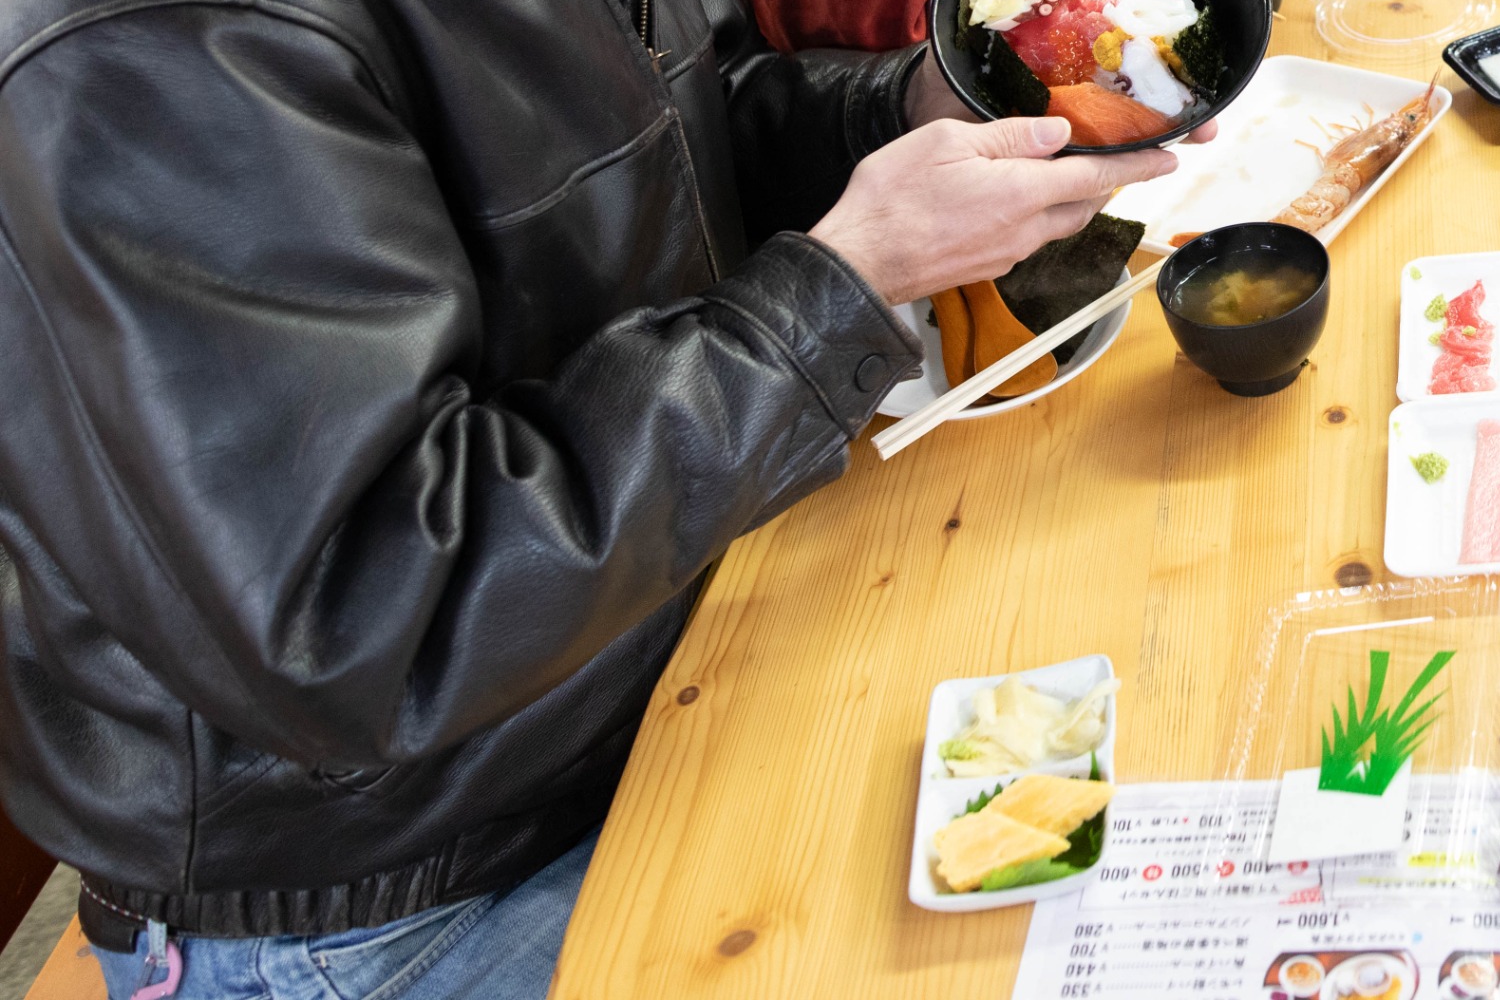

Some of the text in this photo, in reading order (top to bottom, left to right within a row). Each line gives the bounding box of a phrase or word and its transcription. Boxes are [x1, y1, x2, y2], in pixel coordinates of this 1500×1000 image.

[1100, 866, 1138, 881] ¥600
[1297, 912, 1350, 929] ¥1,600
[1074, 923, 1113, 938] ¥280
[1069, 943, 1109, 957] ¥700
[1065, 963, 1107, 978] ¥440
